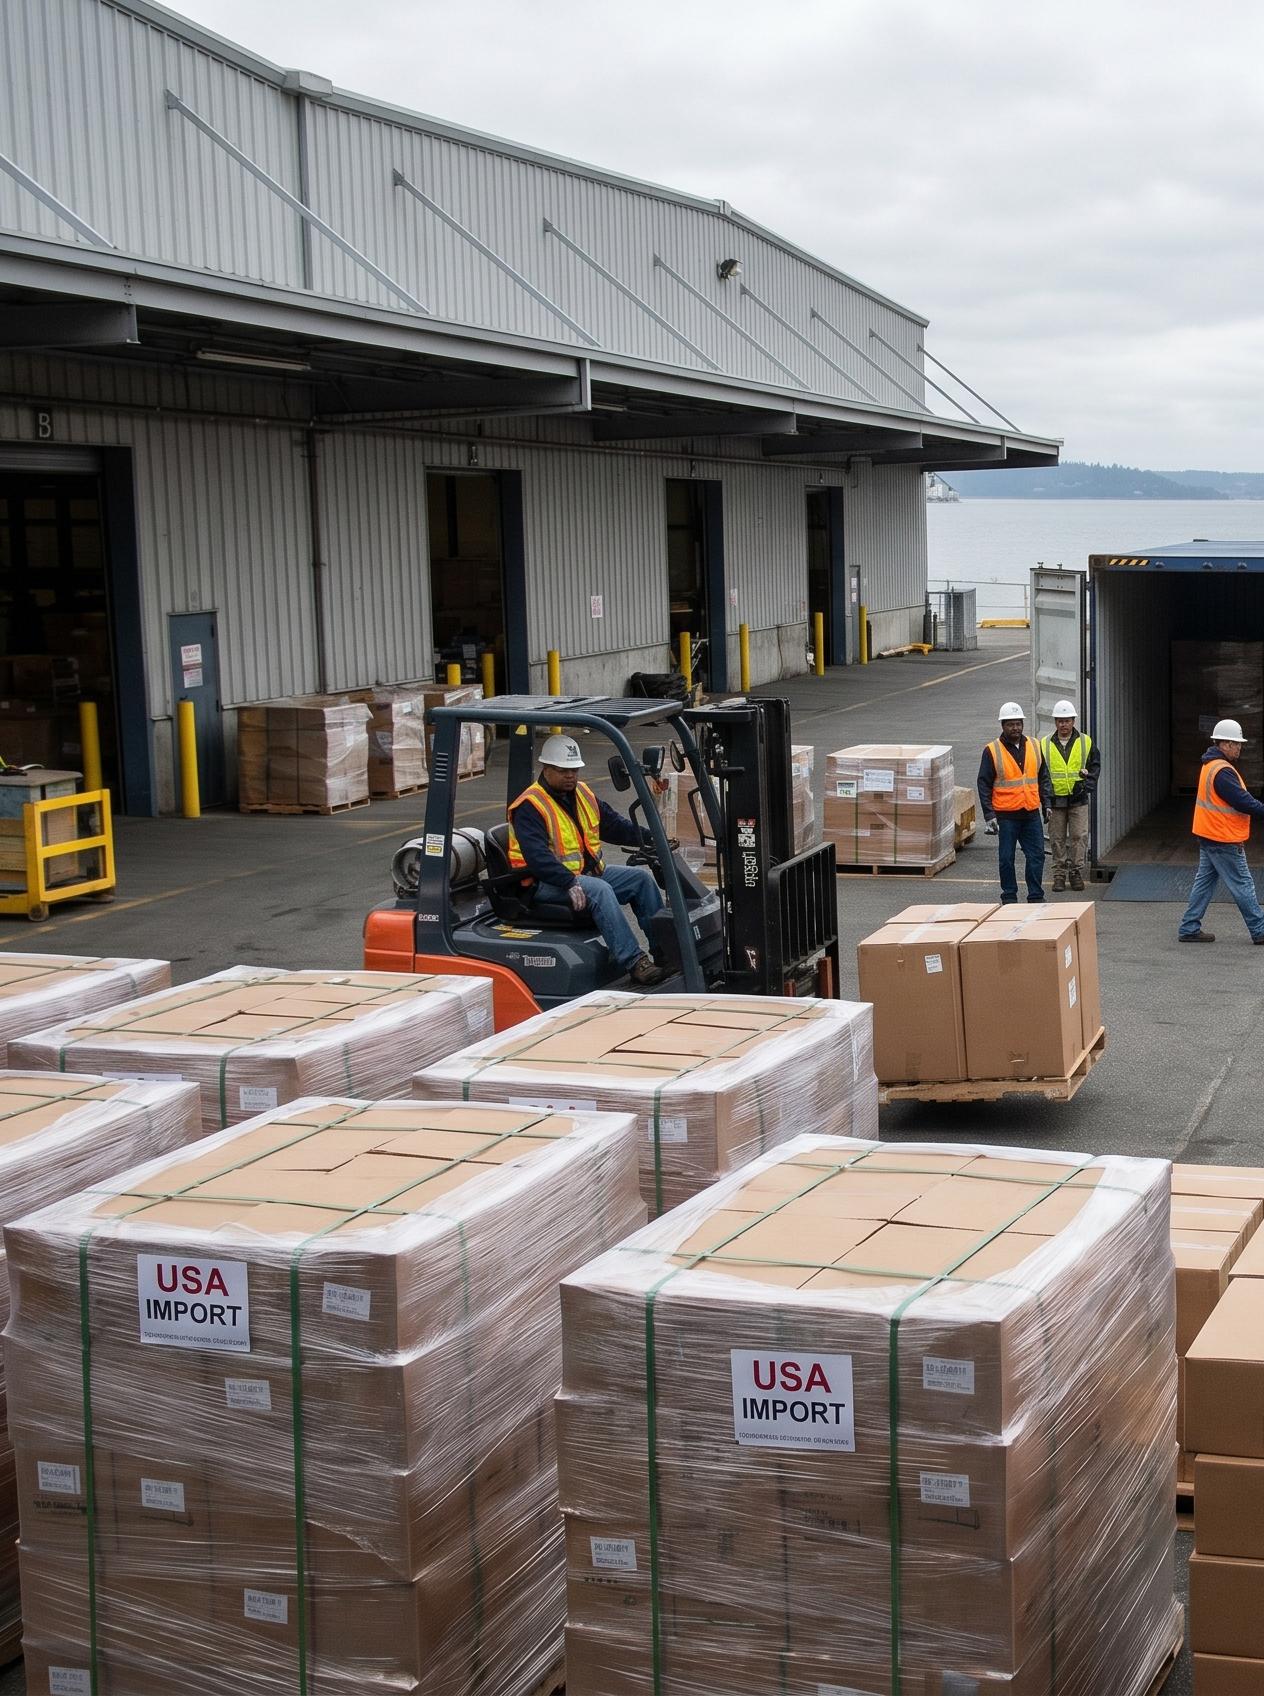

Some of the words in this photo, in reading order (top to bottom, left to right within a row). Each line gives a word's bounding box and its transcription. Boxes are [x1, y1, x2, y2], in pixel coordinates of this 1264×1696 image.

[38, 412, 51, 438] B
[156, 1263, 230, 1297] USA
[146, 1298, 242, 1327] IMPORT
[753, 1360, 833, 1394] USA
[742, 1397, 846, 1425] IMPORT
